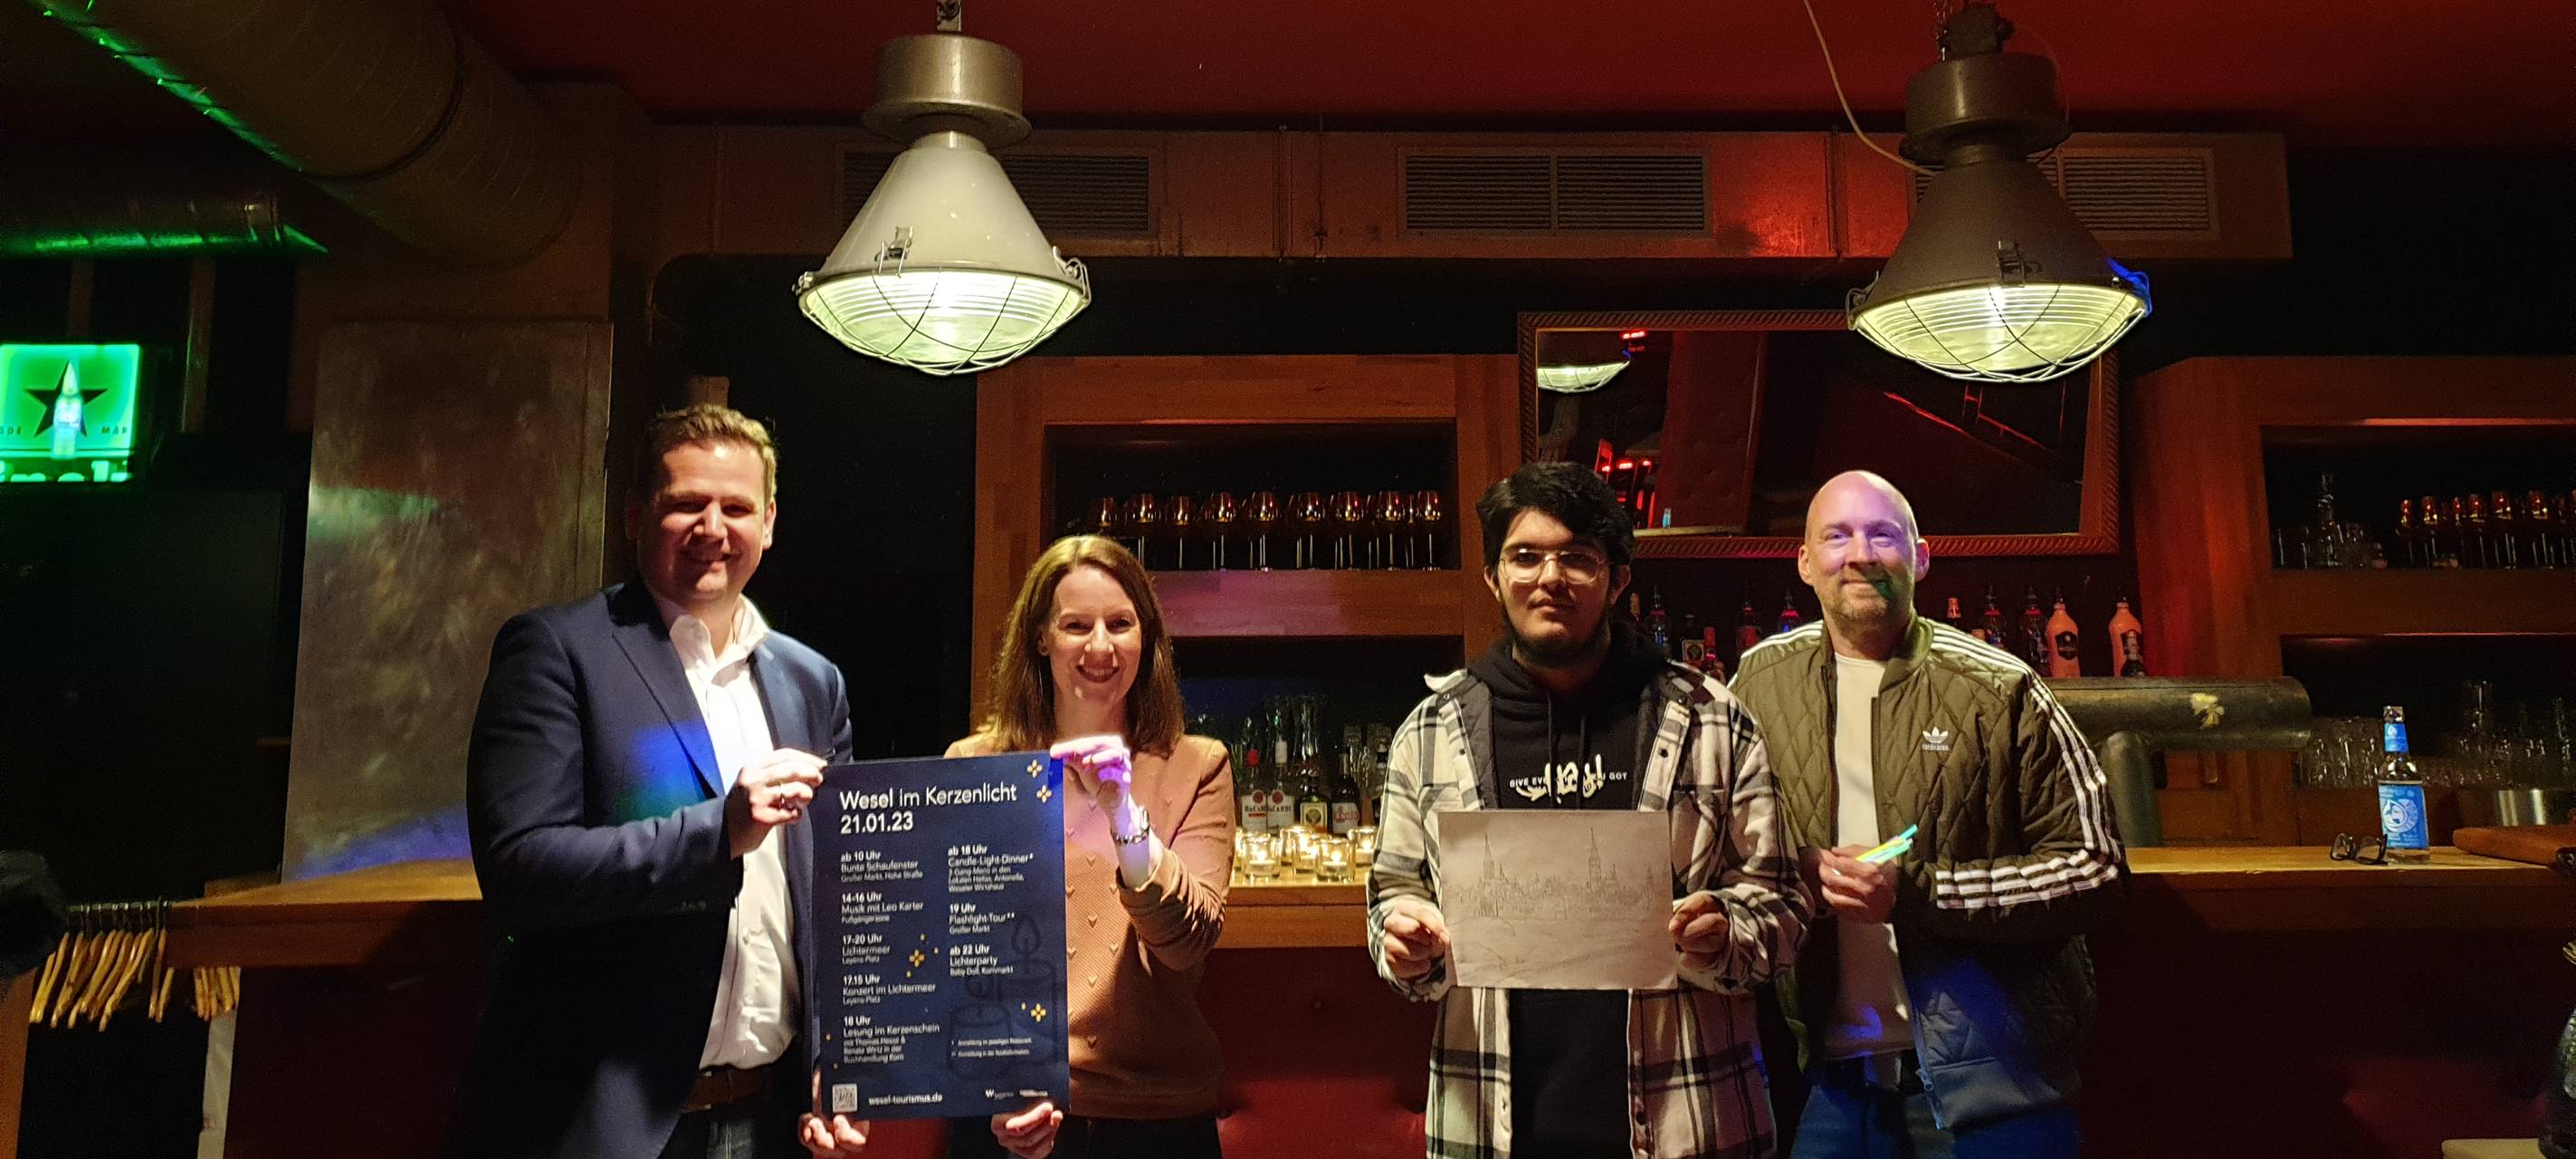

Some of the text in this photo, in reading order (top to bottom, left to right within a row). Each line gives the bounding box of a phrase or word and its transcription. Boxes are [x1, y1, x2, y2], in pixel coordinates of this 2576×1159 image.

[1922, 742, 1949, 752] adidas
[1608, 771, 1627, 781] GOT
[1510, 777, 1529, 788] GIVE
[839, 781, 1017, 810] Wesel im Kerzenlicht
[840, 810, 914, 835] 21.01.23
[948, 843, 987, 856] ab 18 Uhr
[841, 850, 882, 862] ab 10 Uhr
[866, 859, 919, 872] Schaufenster
[842, 891, 883, 903] 14-16 Uhr
[842, 904, 865, 914] Musik
[866, 903, 881, 913] mit
[882, 902, 898, 912] Leo
[949, 902, 976, 914] 19 Uhr
[842, 934, 883, 944] 17-20 Uhr
[949, 943, 990, 955] ab 22 Uhr
[949, 955, 998, 968] Lichterparty
[864, 973, 881, 984] Uhr
[843, 983, 936, 996] Konzert im Lichtermeer
[855, 1015, 871, 1026] Uhr
[844, 1022, 940, 1039] Lesung im Kerzenschein
[868, 1091, 943, 1106] wesel-tourismus.de
